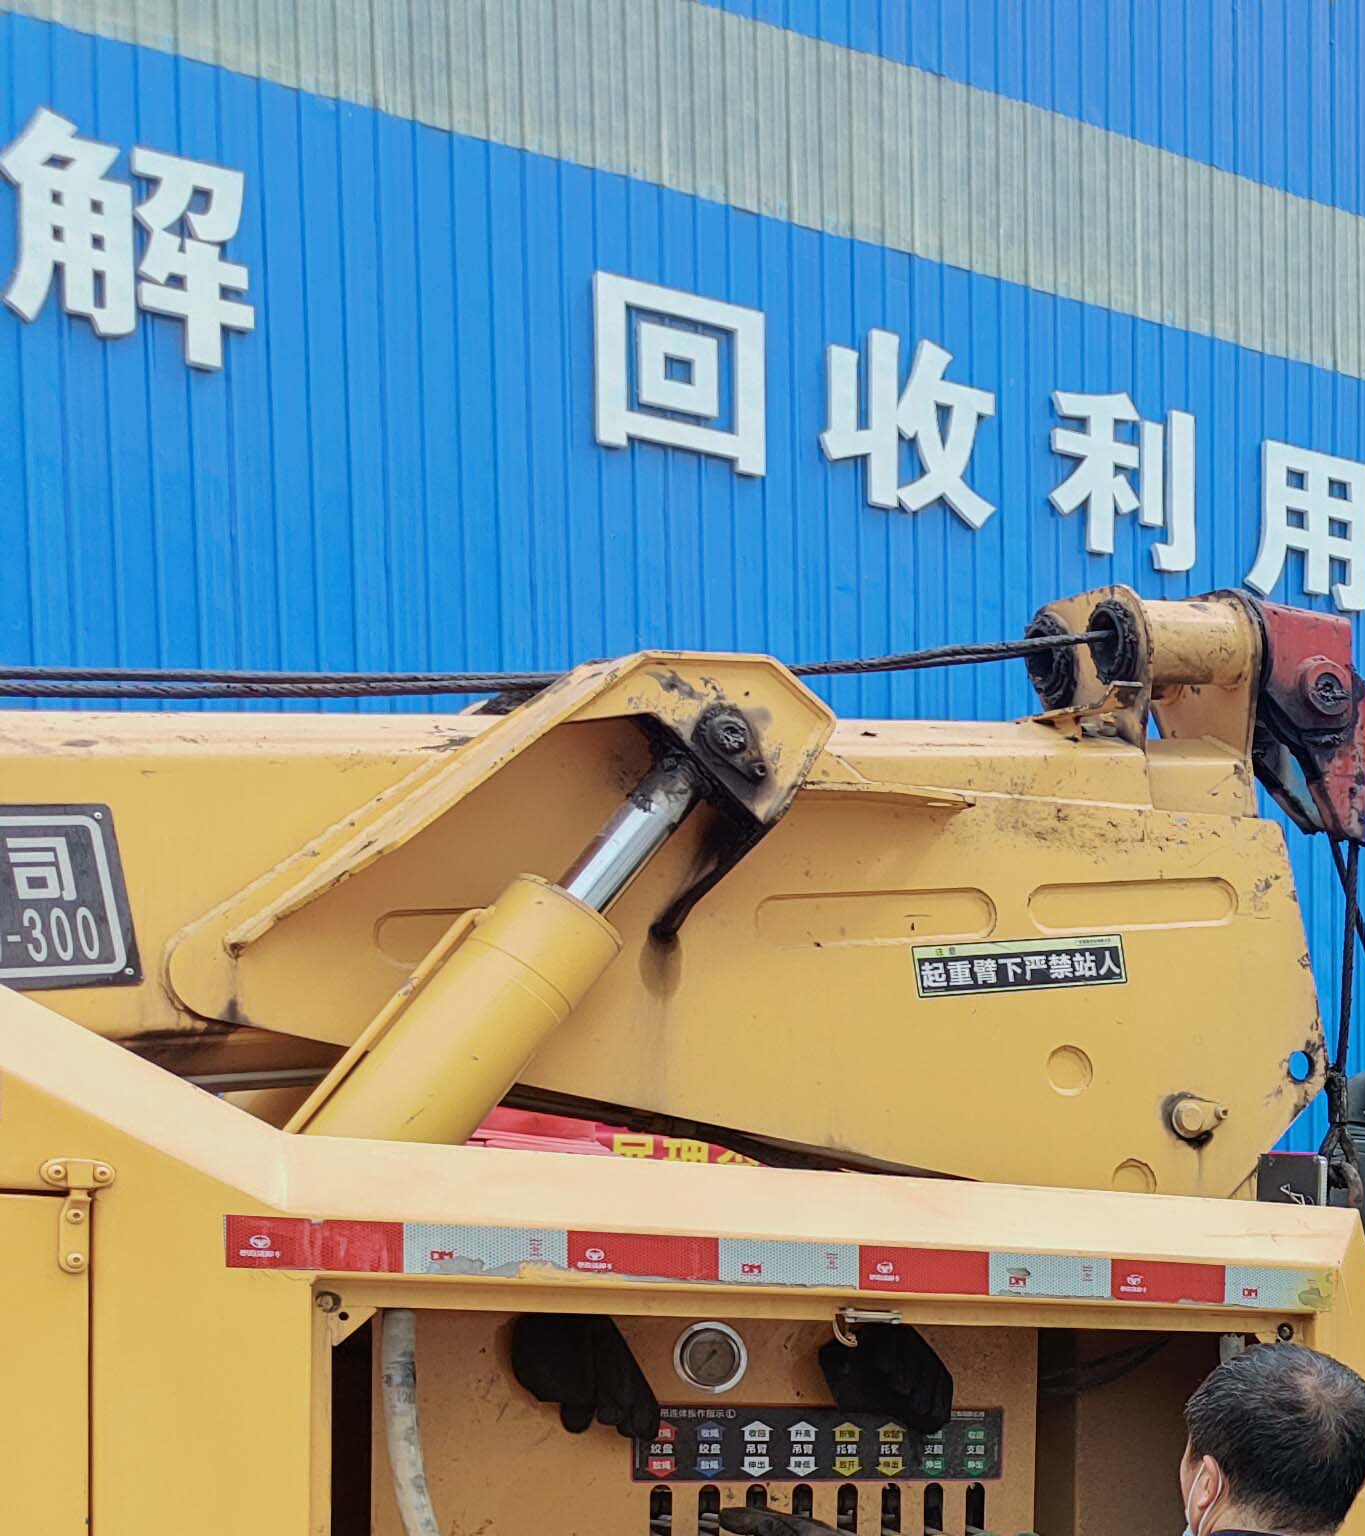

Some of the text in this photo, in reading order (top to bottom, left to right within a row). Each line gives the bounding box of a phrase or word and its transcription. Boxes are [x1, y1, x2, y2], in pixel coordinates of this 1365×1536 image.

[0, 106, 256, 372] 解
[6, 837, 77, 901] 司
[0, 907, 100, 962] -300
[921, 951, 1120, 988] 起重臂下严禁站人
